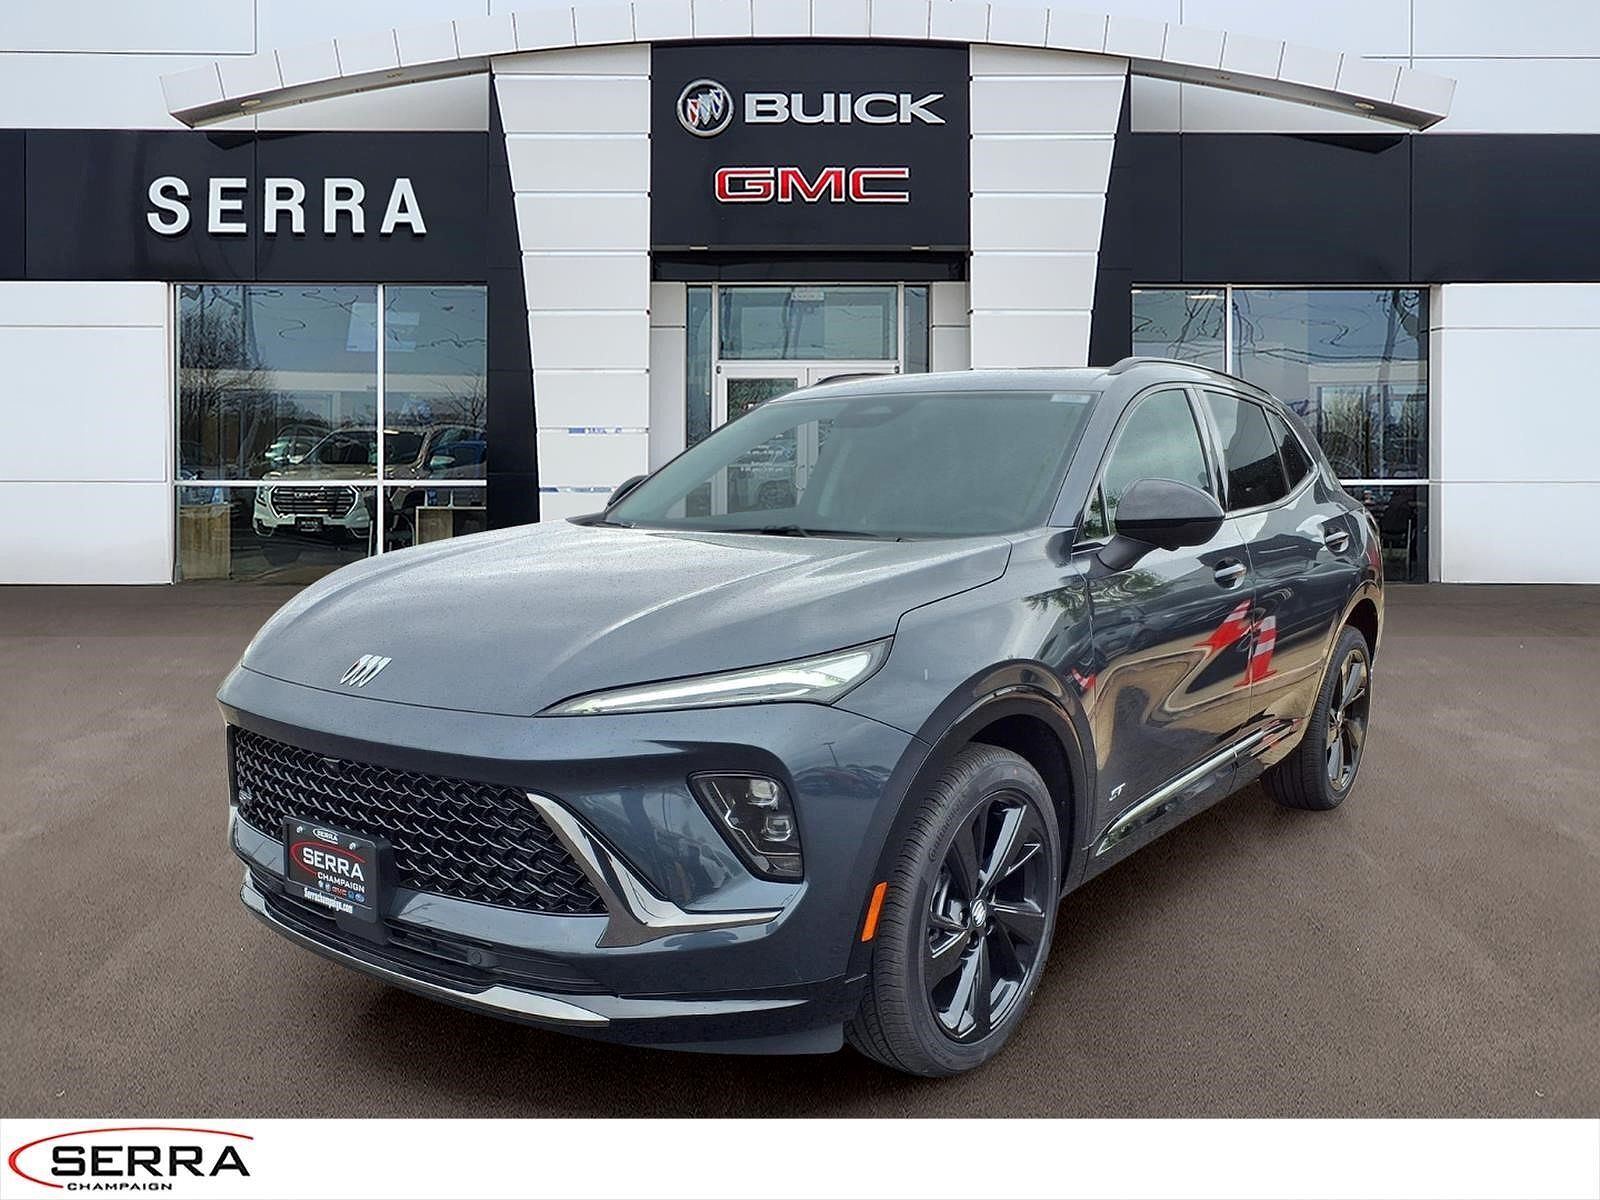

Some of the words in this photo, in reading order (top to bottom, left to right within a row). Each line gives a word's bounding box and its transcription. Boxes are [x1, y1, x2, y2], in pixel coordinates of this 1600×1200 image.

[744, 93, 946, 124] BUICK
[714, 167, 909, 202] GMC
[147, 176, 427, 234] SERRA
[303, 847, 364, 881] SERRA
[317, 871, 365, 893] CHAMPAIGN
